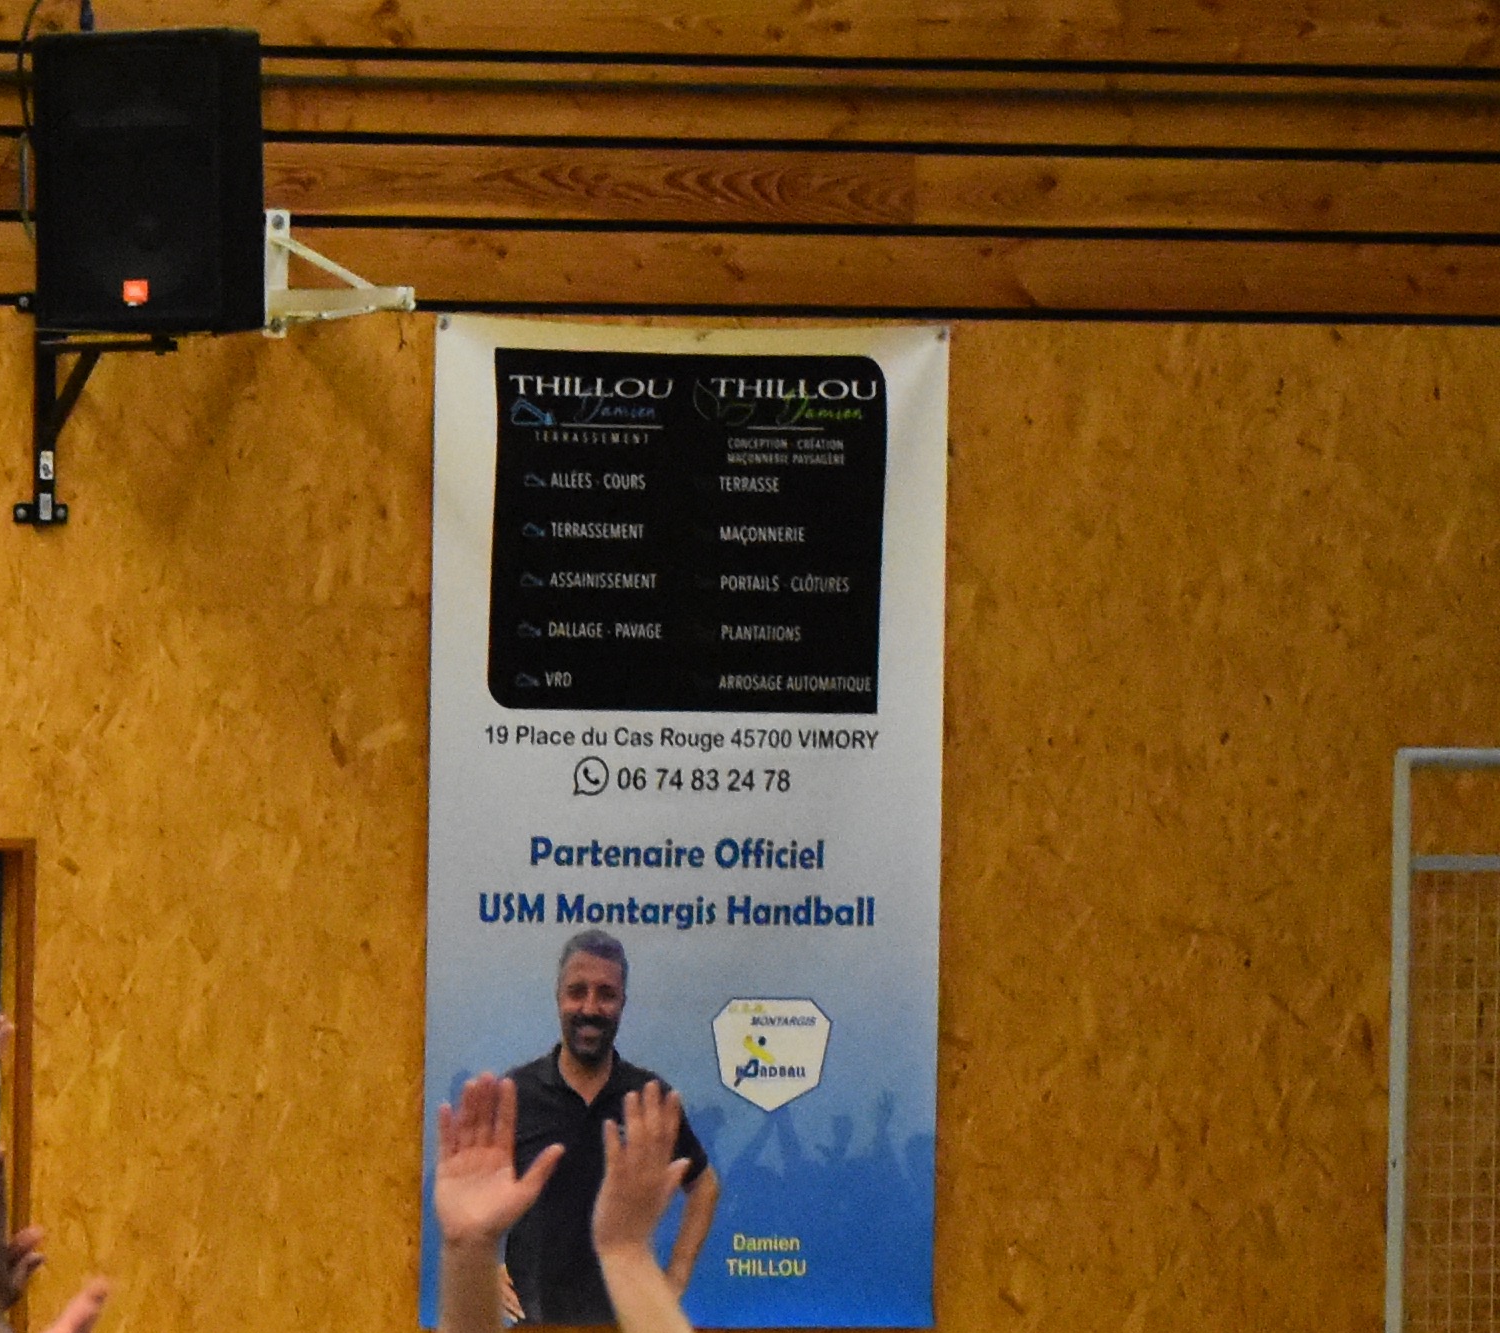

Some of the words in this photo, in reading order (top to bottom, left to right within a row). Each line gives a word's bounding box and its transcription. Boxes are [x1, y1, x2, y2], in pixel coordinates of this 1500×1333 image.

[509, 374, 674, 399] THILLOU
[710, 376, 878, 401] THILLOU
[603, 472, 647, 490] COURS
[719, 476, 780, 493] TERRASSE
[550, 521, 644, 540] TERRASSEMENT
[719, 525, 806, 546] MAÇONNERIE
[549, 572, 657, 589] ASSAINISSEMENT
[720, 575, 780, 592] PORTAILS
[790, 573, 850, 593] CLÔTURES
[548, 621, 603, 639] DALLAGE
[615, 621, 662, 640] PAVAGE
[721, 624, 802, 642] PLANTATIONS
[545, 671, 572, 688] VRD
[718, 674, 782, 692] ARROSAGE
[786, 674, 872, 693] AUTOMATIQUE
[485, 726, 509, 745] 19
[515, 726, 575, 747] Place
[582, 727, 607, 747] du
[614, 728, 653, 747] Cas
[660, 729, 725, 752] Rouge
[730, 730, 792, 749] 45700
[798, 730, 879, 750] VIMORY
[617, 768, 647, 790] 06
[656, 768, 683, 790] 74
[690, 769, 720, 791] 83
[727, 770, 755, 792] 24
[764, 770, 791, 793] 78
[530, 836, 705, 868] Partenaire
[714, 837, 825, 869] Officiel
[479, 892, 545, 923] USM
[556, 893, 717, 930] Montargis
[727, 895, 875, 926] Handball
[733, 1233, 801, 1251] Damien
[726, 1258, 807, 1277] THILLOU
